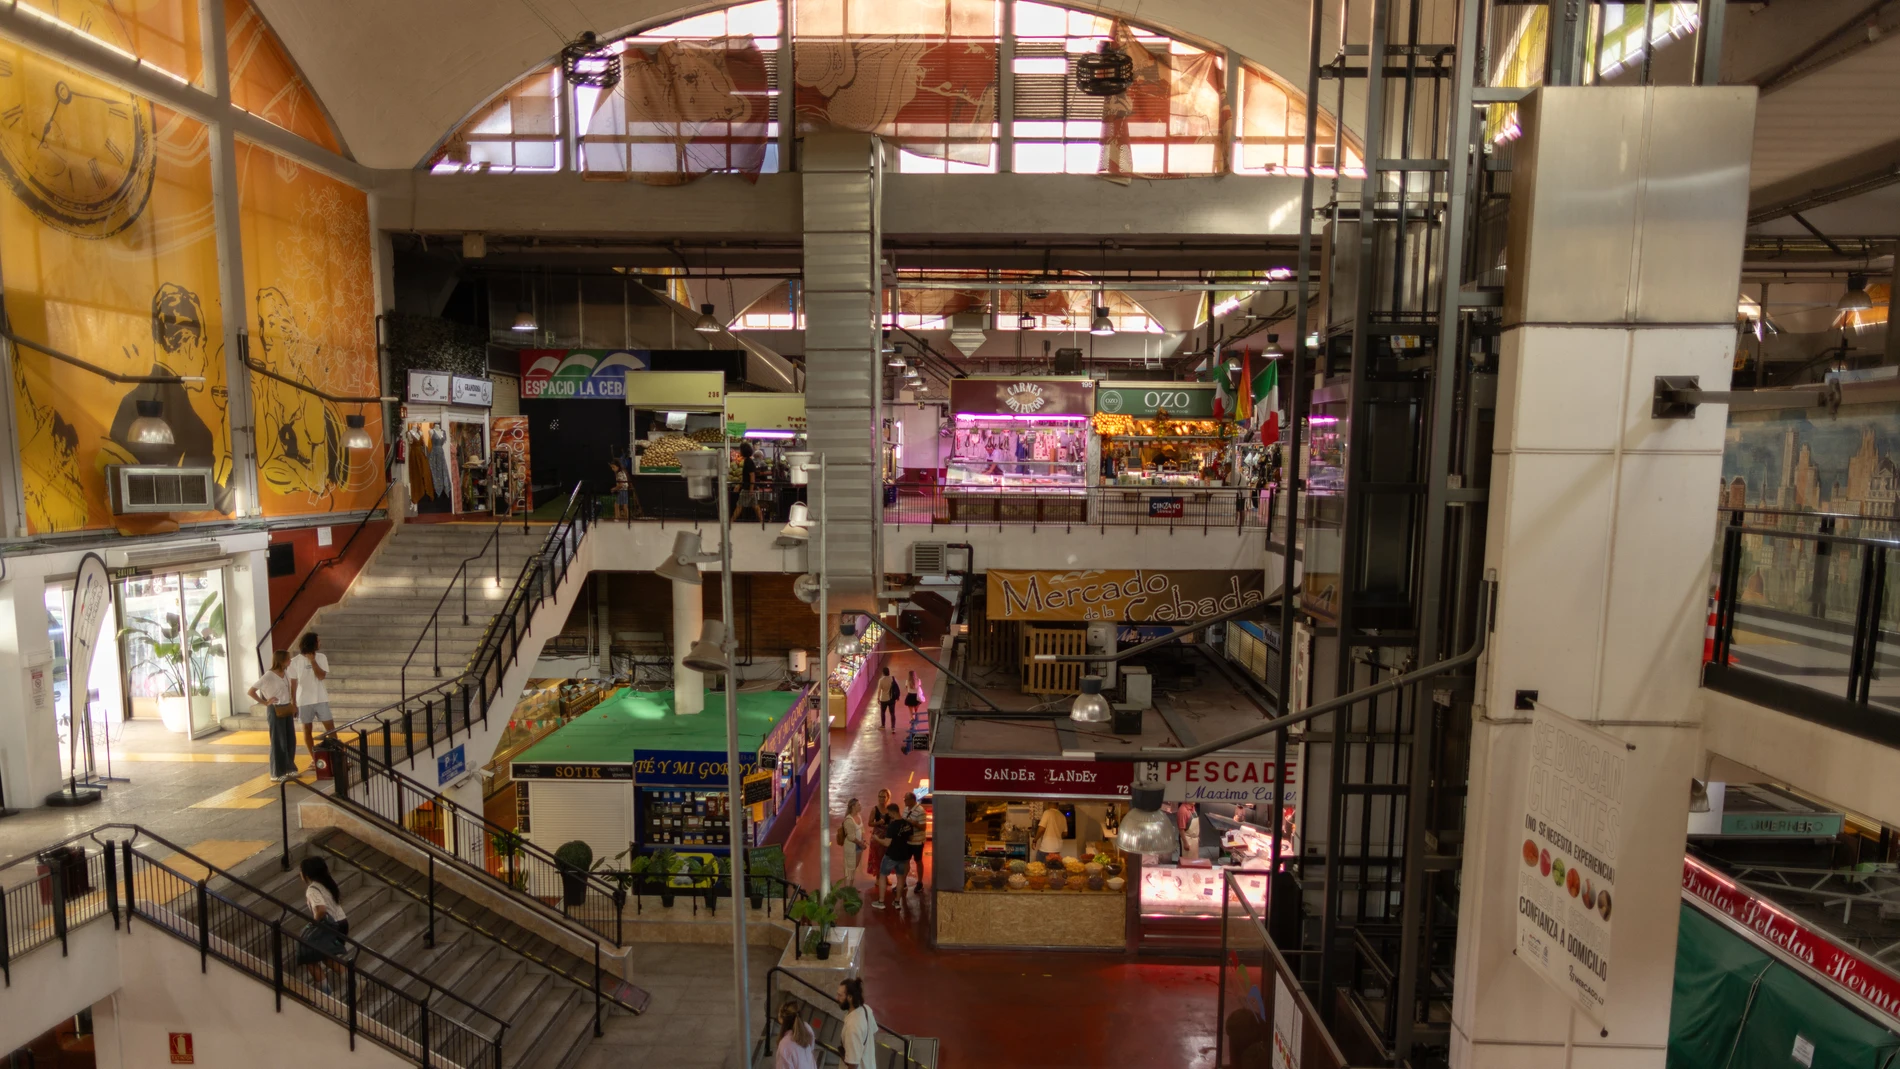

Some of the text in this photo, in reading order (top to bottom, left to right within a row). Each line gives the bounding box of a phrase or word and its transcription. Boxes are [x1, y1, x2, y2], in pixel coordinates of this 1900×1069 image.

[525, 380, 575, 395] ESPACIO
[579, 381, 595, 395] LA
[1007, 382, 1043, 396] CARNES
[1021, 396, 1045, 413] FUEGO
[1144, 391, 1190, 408] OZO
[1001, 569, 1170, 616] Mercado
[1084, 575, 1265, 622] de la Cebada
[657, 760, 671, 774] Y
[672, 761, 697, 774] MI
[1532, 719, 1625, 805] SE BUSCAN
[555, 765, 602, 778] SOTIK
[984, 768, 1098, 783] SANDER LANDEY
[1117, 785, 1130, 794] 72
[1185, 785, 1249, 800] Maximo
[1529, 764, 1620, 860] CLIENTES
[1538, 821, 1547, 838] SE
[1546, 827, 1573, 857] NECESITA
[1574, 843, 1615, 886] EXPERIENCIA)
[1519, 896, 1558, 942] CONFIANZA
[1559, 928, 1565, 948] A
[1567, 933, 1608, 982] DOMICILIO
[1741, 898, 1815, 964] Selectas
[1574, 977, 1598, 1001] MERCADO
